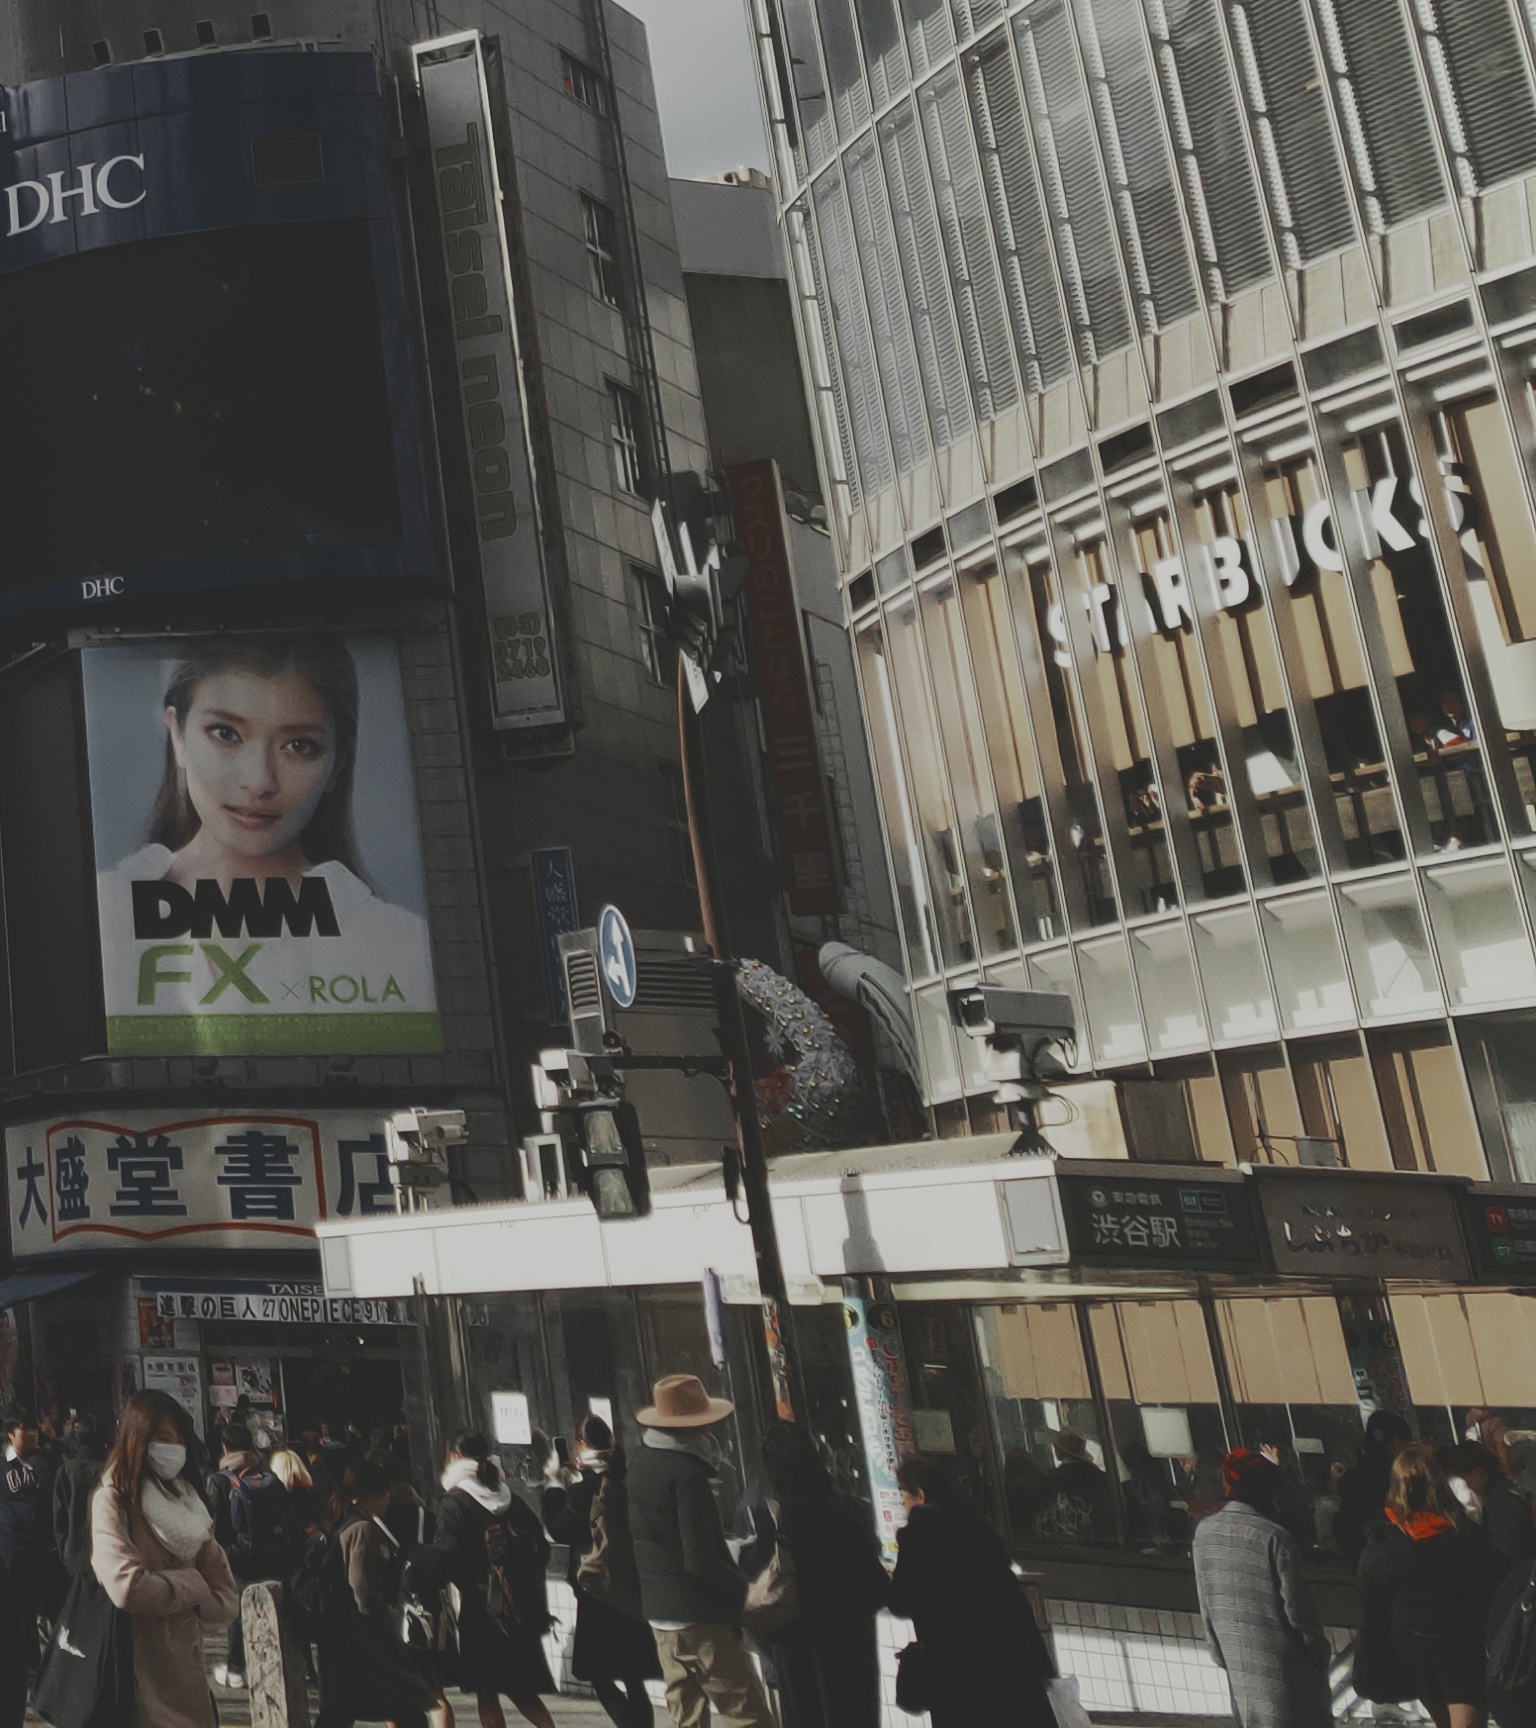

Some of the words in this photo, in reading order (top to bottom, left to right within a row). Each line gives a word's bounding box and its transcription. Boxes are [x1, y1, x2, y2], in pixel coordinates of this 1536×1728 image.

[3, 152, 148, 237] DHC
[81, 575, 126, 601] DHC
[1047, 475, 1466, 669] STRBUCKS
[131, 876, 342, 940] DMM
[137, 943, 271, 1006] FX
[308, 974, 407, 1005] ROLA
[17, 1130, 412, 1229] 大盛堂書店
[1091, 1211, 1182, 1249] 渋谷駅
[158, 1294, 258, 1320] 進撃の巨人
[262, 1299, 276, 1319] 27
